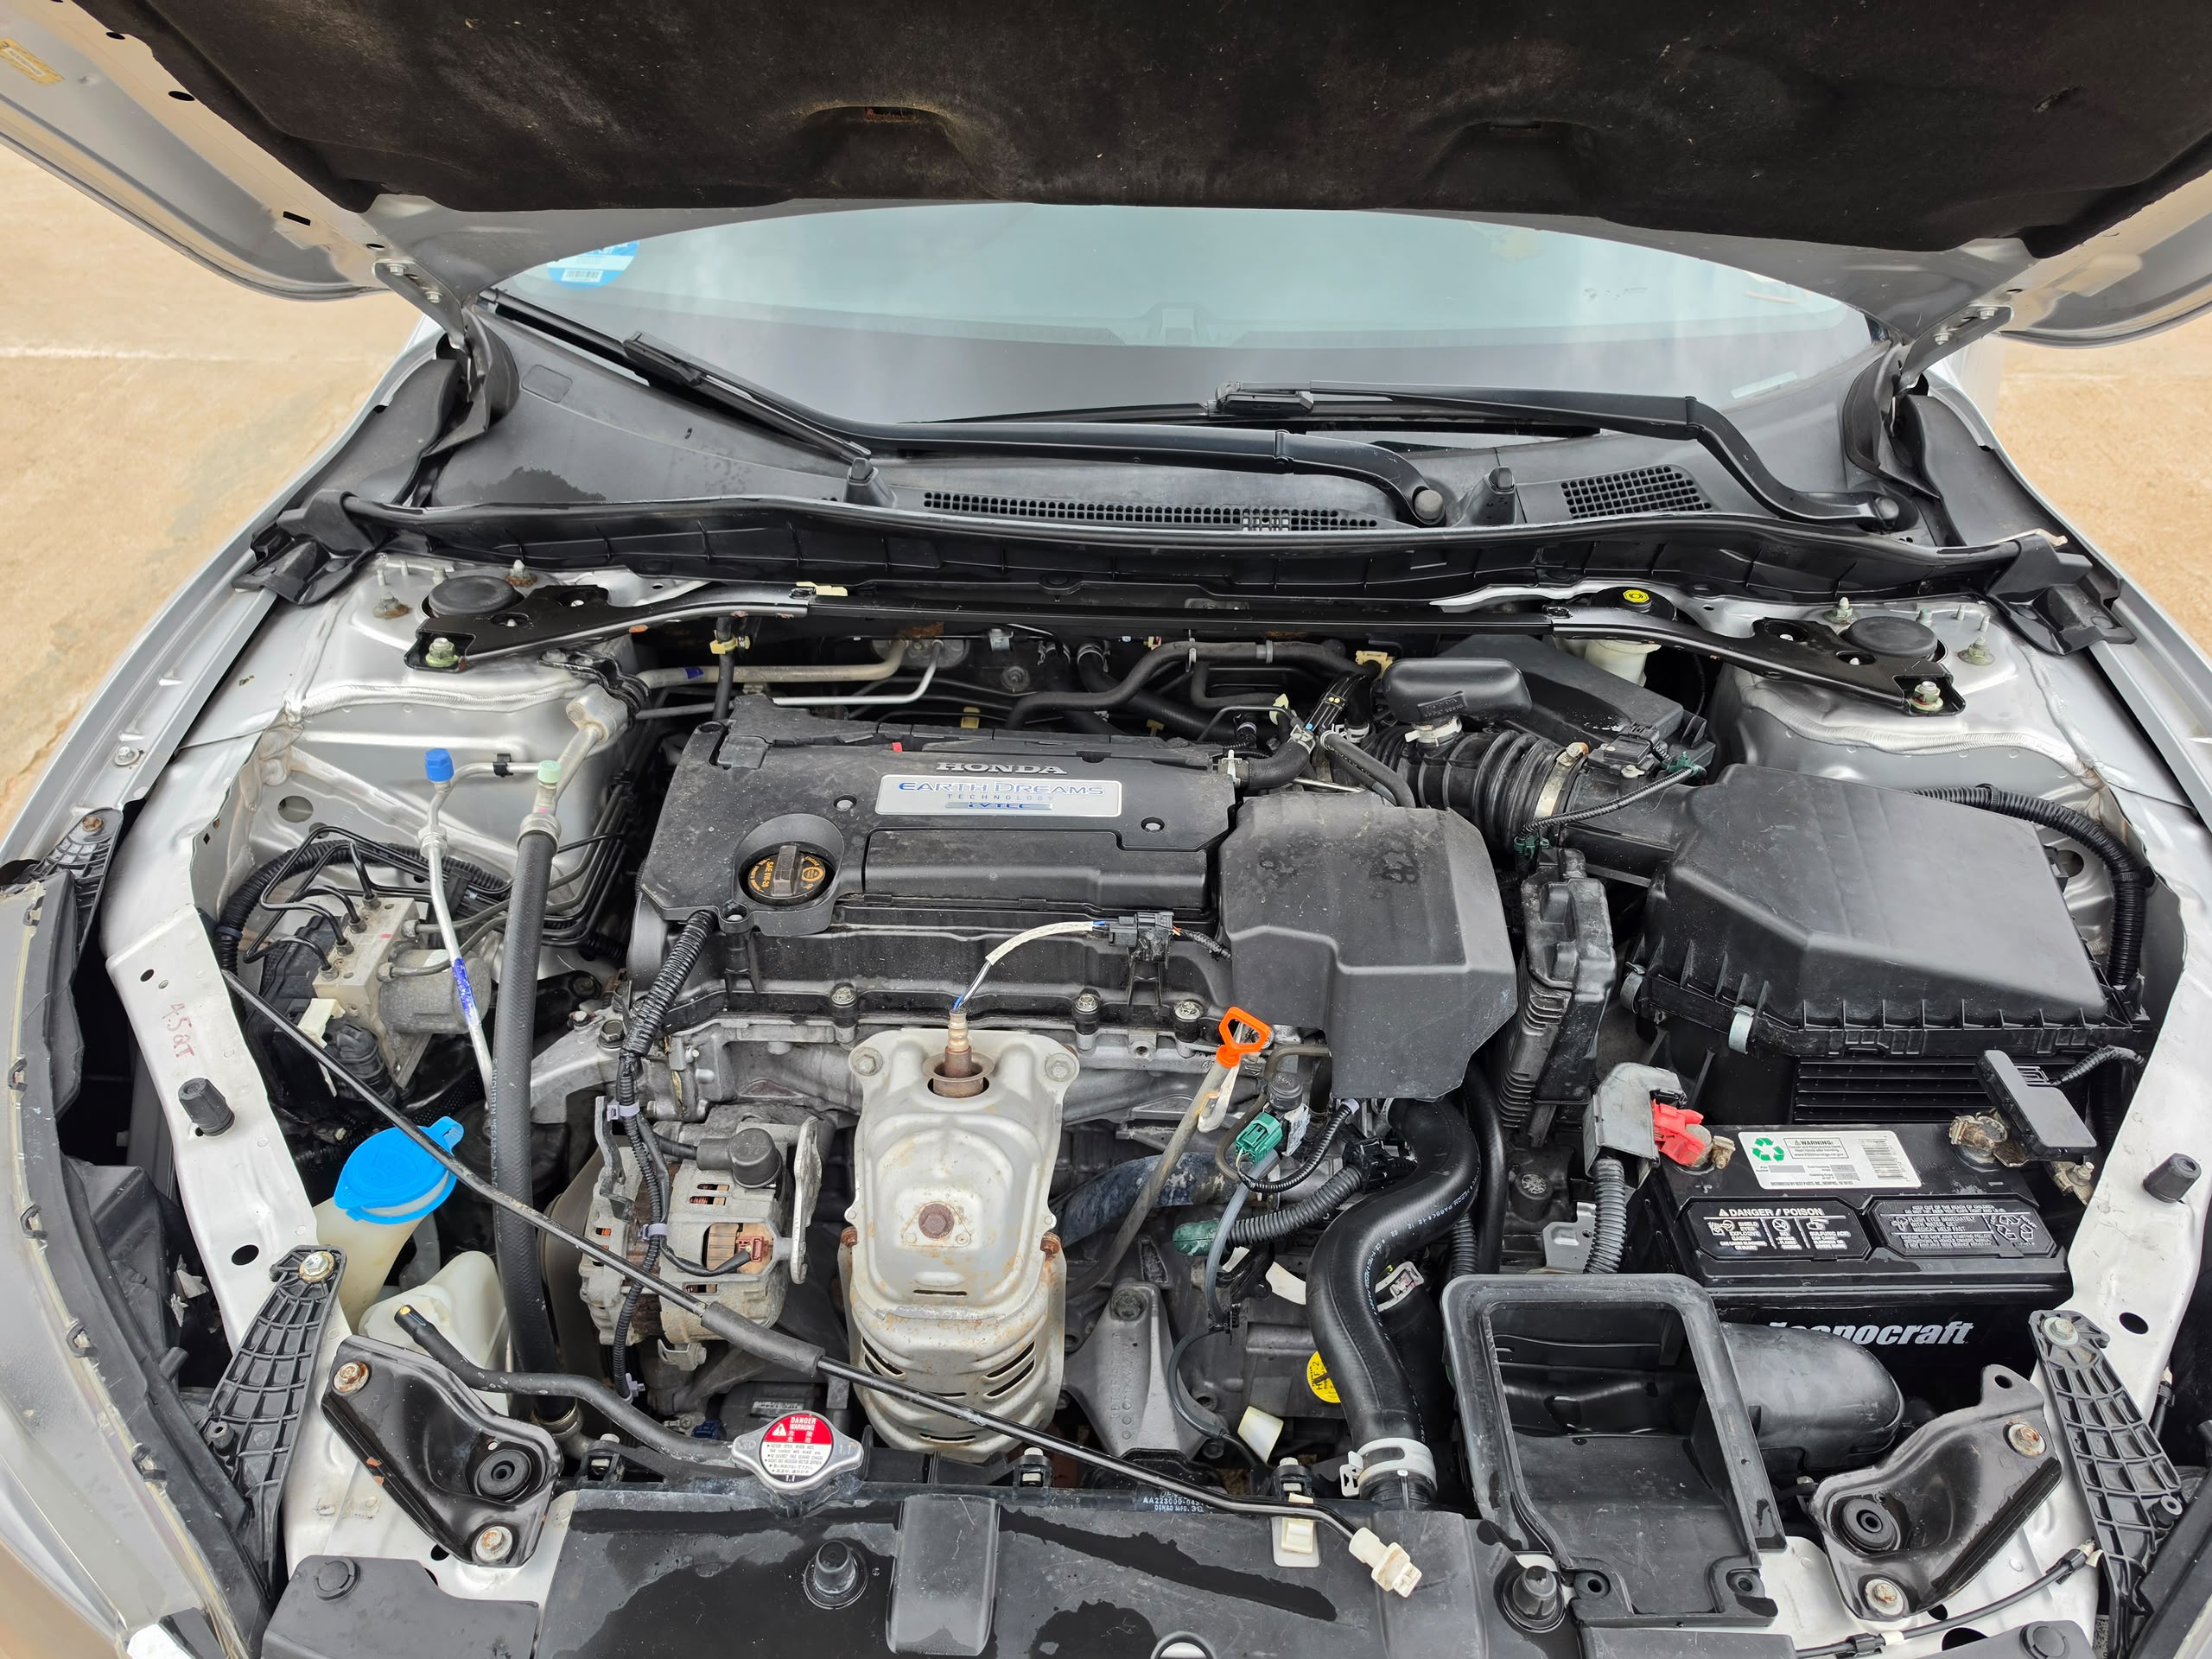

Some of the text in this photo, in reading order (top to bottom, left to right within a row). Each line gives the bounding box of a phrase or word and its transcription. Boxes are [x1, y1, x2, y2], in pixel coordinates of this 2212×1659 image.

[936, 762, 1068, 775] HONDA
[899, 781, 1105, 795] EARTH DREAMS
[1770, 1321, 1974, 1345] nocraft
